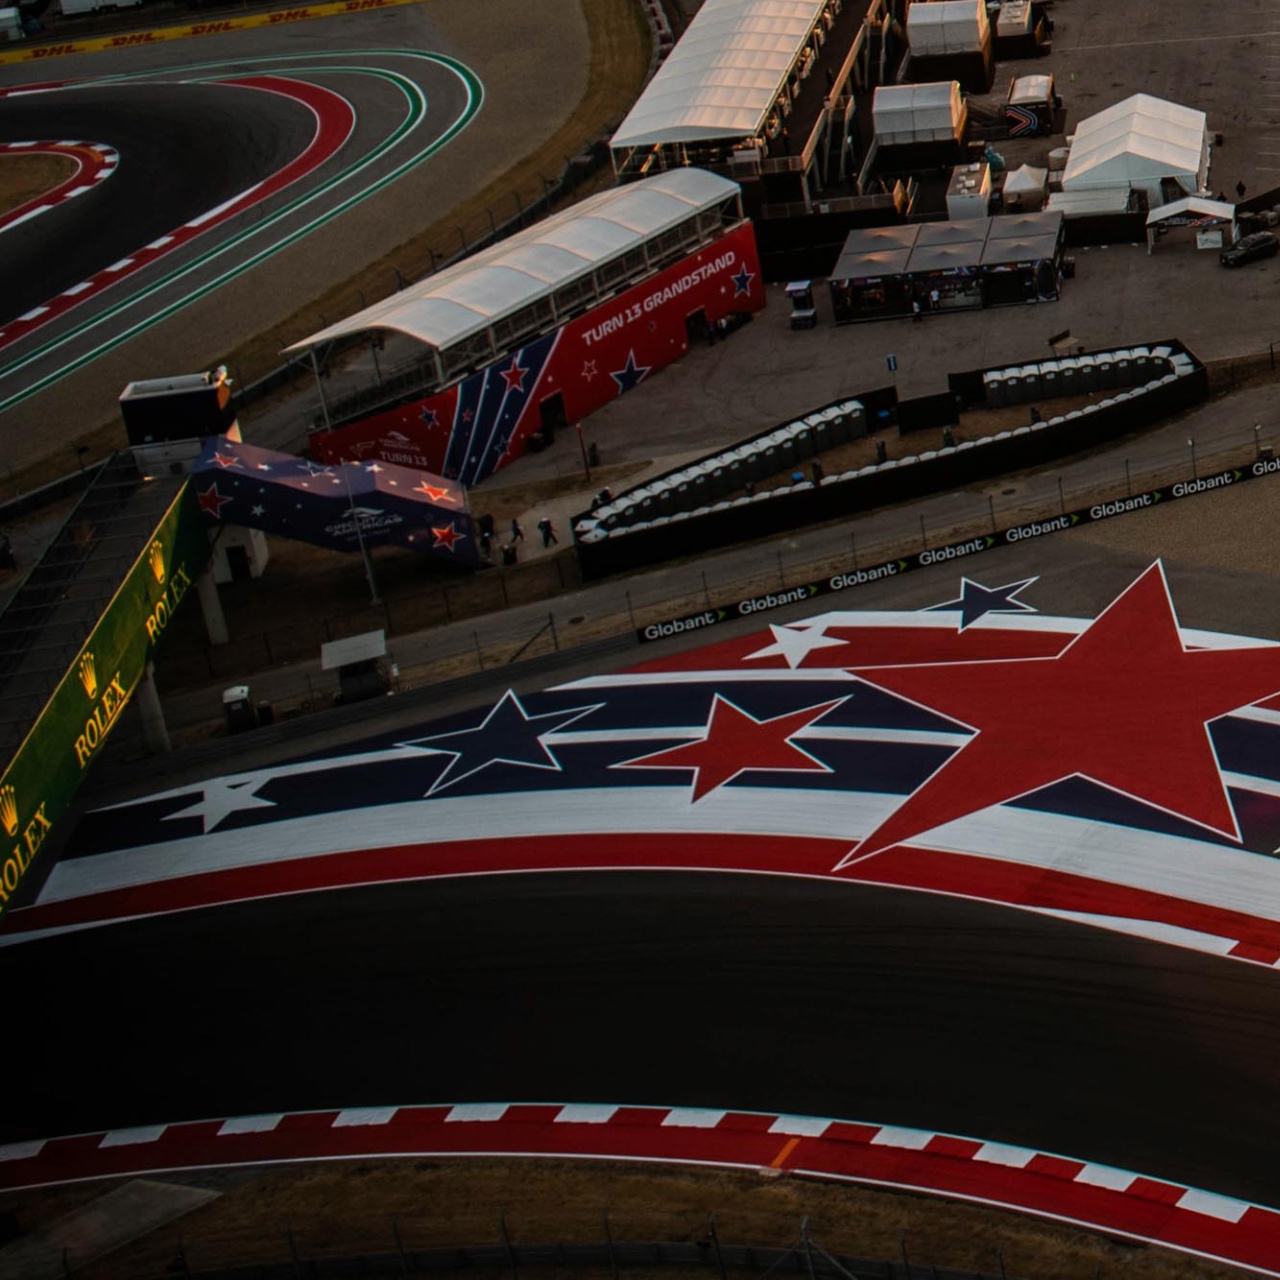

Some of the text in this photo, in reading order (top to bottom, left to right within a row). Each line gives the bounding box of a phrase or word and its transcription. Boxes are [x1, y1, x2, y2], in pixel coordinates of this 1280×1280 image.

[192, 21, 234, 34] DHL
[268, 10, 311, 22] DHL
[32, 44, 76, 58] DHL
[112, 33, 156, 46] DHL
[581, 251, 736, 347] TURN 13 GRANDSTAND
[379, 451, 428, 466] TURN 13
[1173, 472, 1233, 497] Globant
[1090, 493, 1151, 519] Globant
[1006, 516, 1069, 542] Globant
[919, 538, 984, 563] Globant
[830, 563, 897, 590] Globant
[145, 561, 192, 646] ROLEX
[738, 586, 807, 615] Globant
[645, 610, 715, 640] Globant
[74, 670, 127, 769] ROLEX
